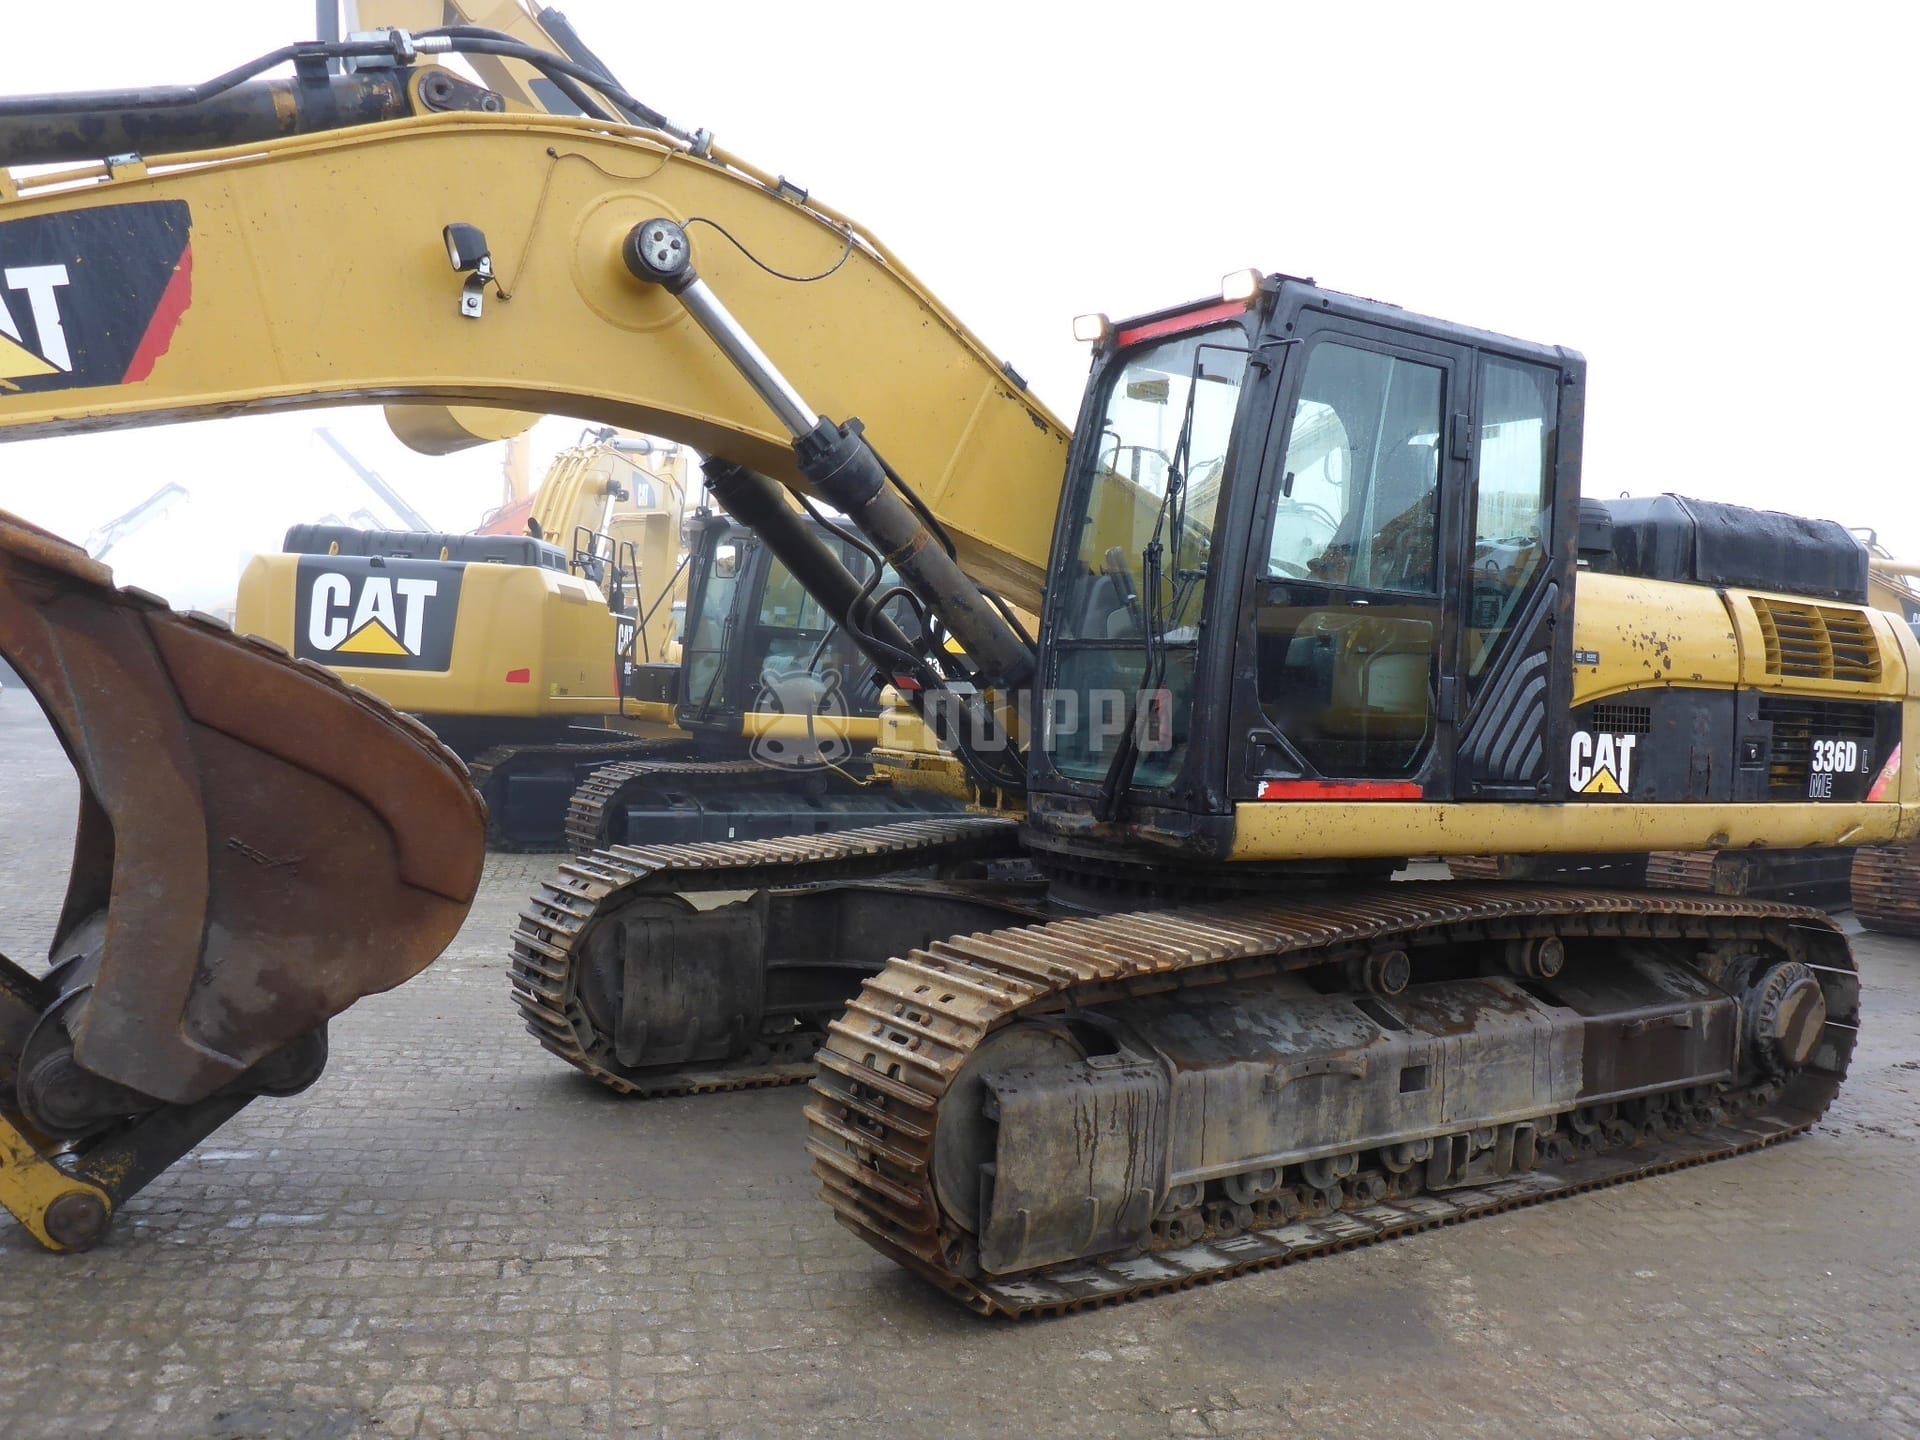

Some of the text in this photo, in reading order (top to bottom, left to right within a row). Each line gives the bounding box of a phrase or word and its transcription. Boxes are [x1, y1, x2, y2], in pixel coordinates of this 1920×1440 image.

[309, 572, 438, 656] CAT
[617, 623, 634, 657] CAT
[1569, 730, 1636, 794] CAT
[1812, 740, 1858, 773] 336D
[1808, 773, 1833, 798] ME
